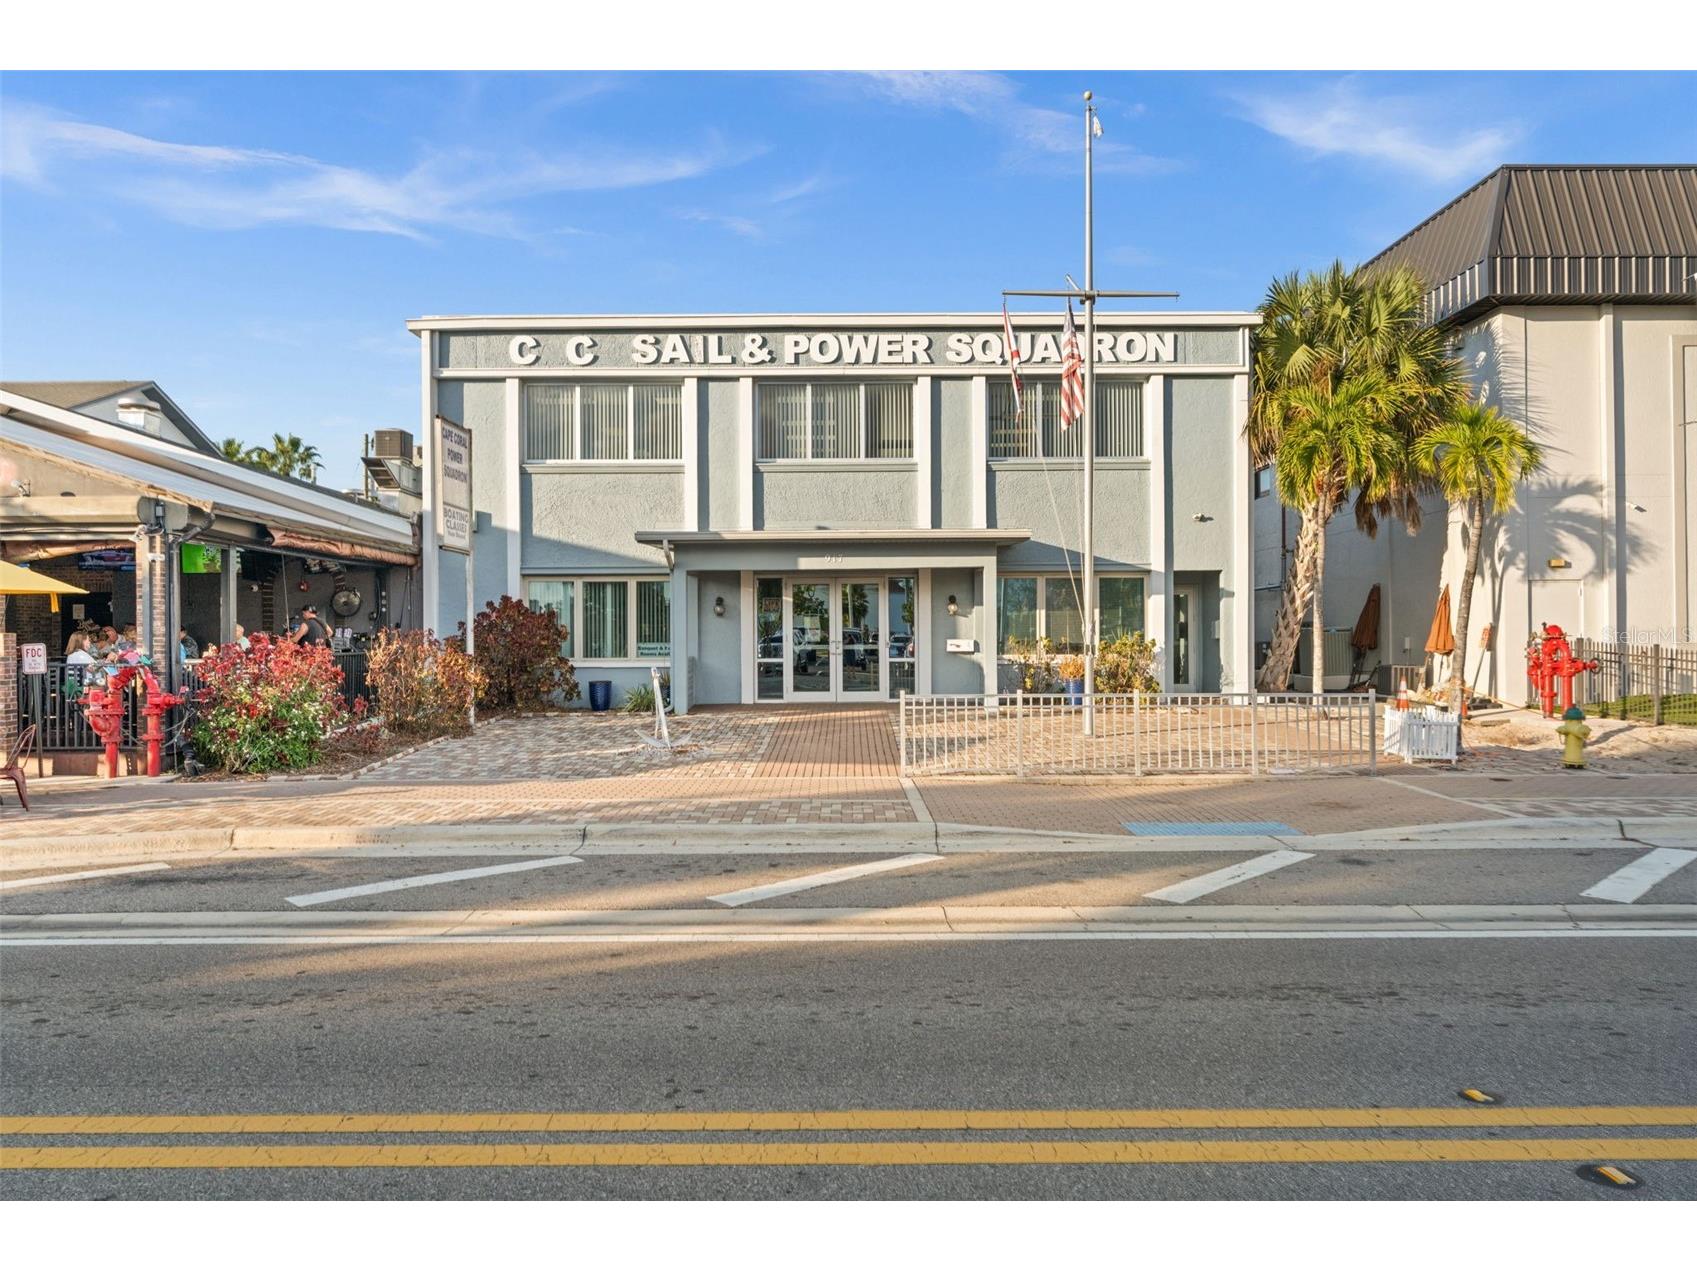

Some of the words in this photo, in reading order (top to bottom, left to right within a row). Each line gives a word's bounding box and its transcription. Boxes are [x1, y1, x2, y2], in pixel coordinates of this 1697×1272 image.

[508, 334, 538, 365] C
[565, 334, 595, 365] C
[632, 334, 733, 364] SAIL
[740, 334, 773, 364] &
[784, 333, 930, 363] POWER
[946, 332, 1175, 364] SQUARON
[26, 648, 41, 658] FDC
